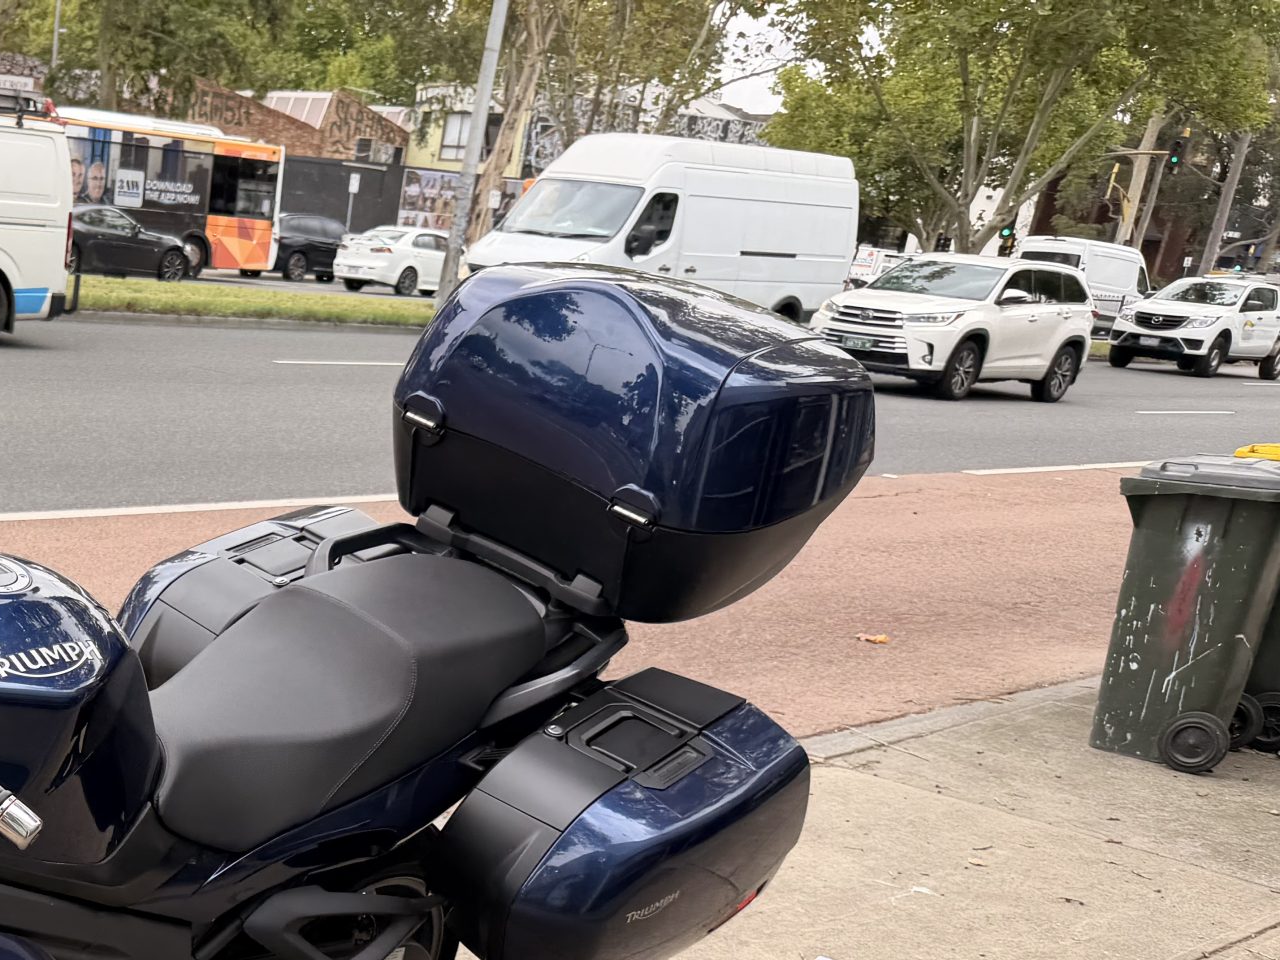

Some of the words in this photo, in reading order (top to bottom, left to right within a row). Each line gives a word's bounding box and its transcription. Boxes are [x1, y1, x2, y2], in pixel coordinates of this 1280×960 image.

[145, 179, 194, 193] DOWNLOAD
[144, 190, 160, 201] THE
[626, 890, 680, 924] TRIUMPH
